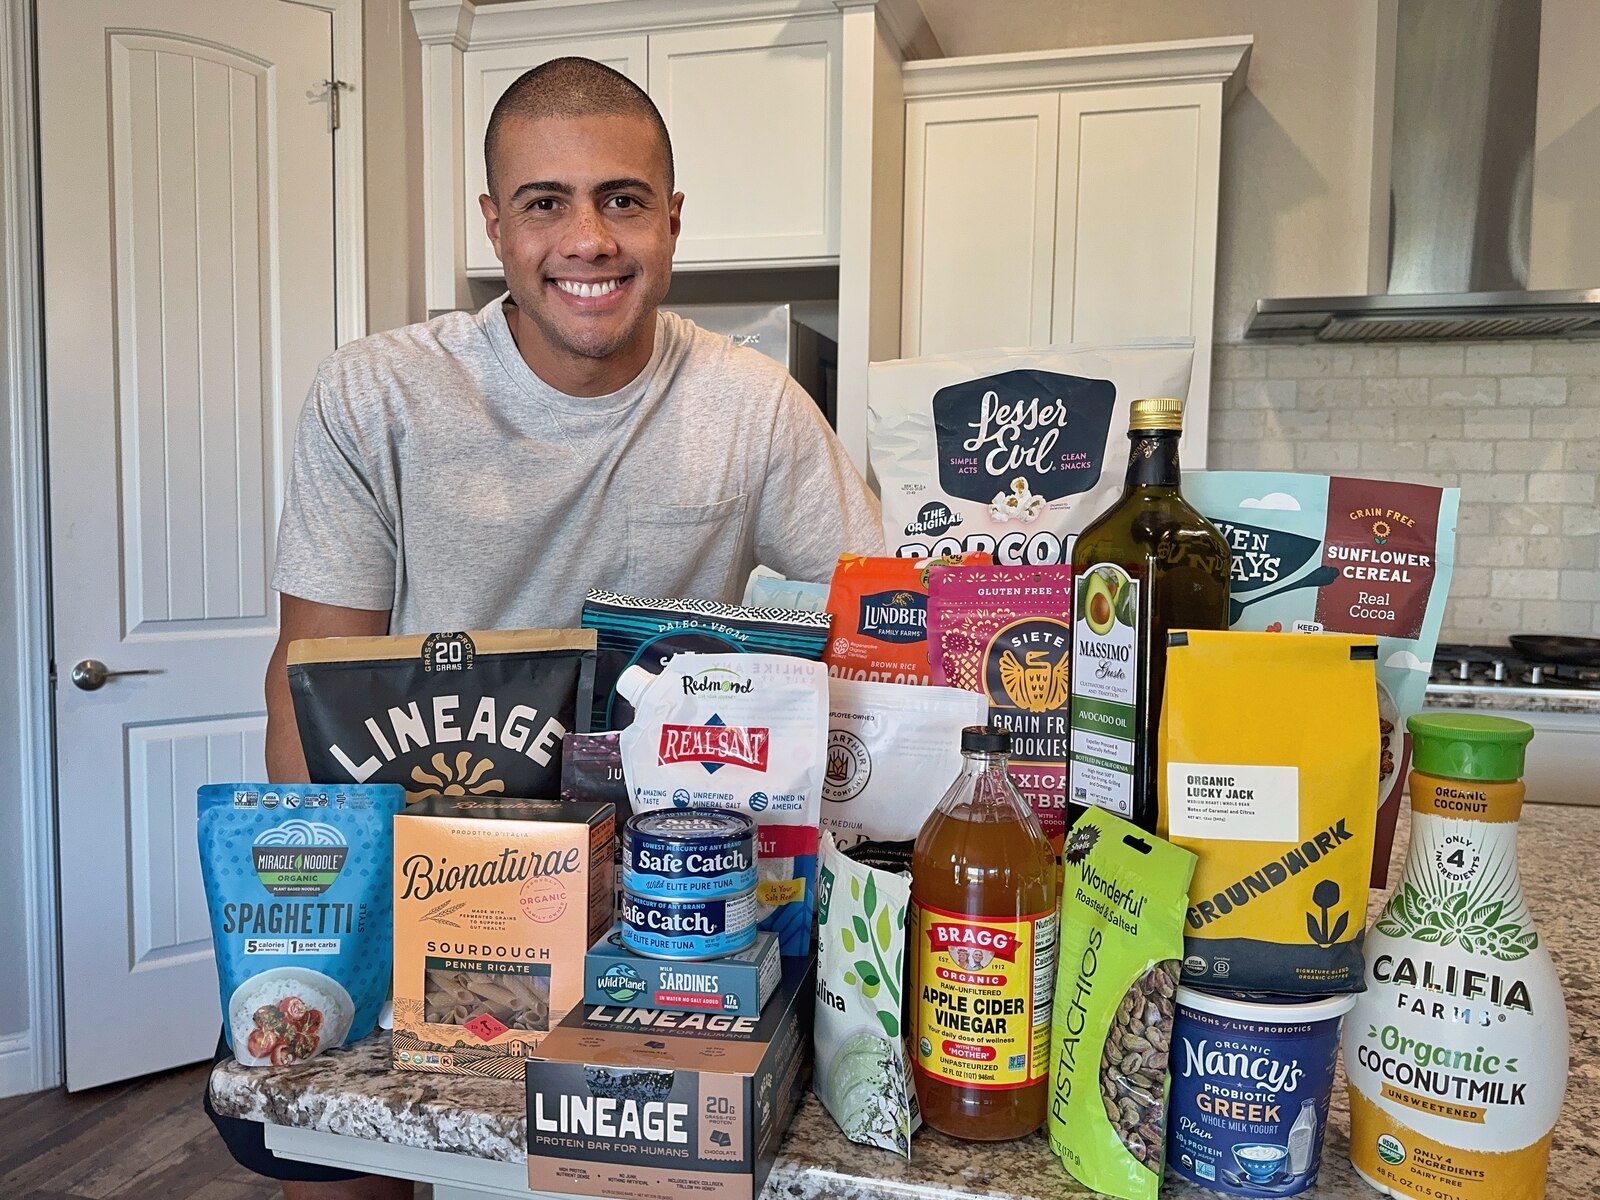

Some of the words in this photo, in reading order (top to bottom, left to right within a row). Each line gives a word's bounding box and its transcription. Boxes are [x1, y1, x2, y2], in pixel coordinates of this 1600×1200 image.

[964, 391, 1067, 452] Lesser
[986, 424, 1060, 476] Evil
[1061, 453, 1087, 461] CLEAN
[950, 457, 978, 466] SIMPLE
[958, 466, 978, 474] ACTS
[1060, 461, 1091, 470] SNACKS
[907, 513, 964, 533] ORIGINAL
[923, 508, 946, 521] THE
[1350, 508, 1382, 520] GRAIN
[1386, 509, 1415, 528] FREE
[1327, 546, 1431, 567] SUNFLOWER
[1343, 566, 1412, 583] CEREAL
[978, 587, 1021, 596] GLUTEN
[1024, 587, 1053, 595] FREE
[1358, 591, 1389, 605] Real
[1349, 605, 1395, 621] Cocoa
[658, 620, 698, 633] PALEO
[711, 622, 749, 642] VEGAN
[878, 628, 899, 636] FAMILY
[900, 629, 921, 637] FARMS
[1011, 632, 1064, 648] SIETE
[425, 632, 453, 672] GRASS-FED
[456, 633, 473, 670] PROTEIN
[435, 641, 462, 663] 20
[1079, 640, 1129, 662] MASSIMO
[870, 660, 898, 669] BROWN
[899, 663, 917, 671] RICE
[1095, 660, 1126, 680] Gusto
[993, 714, 1040, 734] GRAIN
[1079, 711, 1114, 725] AVOCADO
[1115, 718, 1127, 728] OIL
[329, 695, 566, 784] LINEAGE
[833, 734, 867, 766] ARTHUR
[833, 777, 863, 797] COMPANY
[1187, 775, 1235, 788] ORGANIC
[643, 789, 667, 797] AMAZING
[643, 798, 660, 806] TASTE
[693, 792, 734, 801] UNREFINED
[797, 794, 805, 802] IN
[1187, 787, 1222, 799] LUCKY
[1226, 788, 1254, 800] JACK
[1435, 786, 1487, 801] ORGANIC
[693, 801, 722, 809] MINERAL
[772, 803, 802, 811] AMERICA
[1434, 799, 1488, 813] COCONUT
[830, 818, 863, 829] MEDIUM
[642, 841, 665, 851] LOWEST
[709, 843, 722, 851] ANY
[723, 841, 742, 849] BRAND
[1071, 841, 1090, 851] Shells
[1078, 833, 1090, 841] No
[1445, 835, 1473, 848] ONLY
[258, 855, 293, 870] MIRACLE
[303, 855, 338, 870] NOODLE
[638, 850, 683, 872] Safe
[686, 849, 747, 873] Catch
[1435, 850, 1480, 881] INGREDIENTS
[1447, 849, 1465, 868] 4
[400, 848, 581, 900] Bionaturae
[1186, 818, 1354, 930] GROUNDWORK
[645, 880, 665, 890] Wild
[667, 882, 688, 891] ELITE
[690, 881, 711, 890] PURE
[714, 879, 733, 889] TUNA
[1081, 861, 1144, 918] Wonderful
[520, 892, 567, 905] ORGANIC
[633, 896, 657, 908] MERCURY
[658, 901, 666, 909] OF
[667, 902, 681, 910] ANY
[224, 903, 353, 934] SPAGHETTI
[358, 903, 367, 933] STYLE
[525, 906, 546, 921] FAMILY
[1075, 888, 1105, 915] Roasted
[1103, 907, 1109, 919] &
[1108, 912, 1137, 936] Salted
[647, 910, 716, 934] Catch
[247, 940, 257, 953] 5
[258, 941, 285, 949] calories
[290, 940, 297, 953] 1
[634, 932, 650, 945] ELITE
[650, 936, 671, 948] PURE
[672, 939, 695, 949] TUNA
[938, 926, 1008, 949] BRAGG
[427, 941, 550, 959] SOURDOUGH
[445, 960, 482, 971] PENNE
[488, 963, 530, 973] RIGATE
[938, 956, 950, 964] EST.
[597, 976, 618, 988] Wild
[618, 978, 646, 991] Planet
[659, 972, 719, 994] SARDINES
[942, 970, 1000, 985] ORGANIC
[1373, 954, 1533, 1015] CALIFIA
[940, 982, 1002, 996] RAW-UNFILTERED
[923, 986, 968, 1013] APPLE
[973, 998, 1025, 1015] CIDER
[587, 1005, 760, 1033] LINEAGE
[1397, 993, 1491, 1027] FARMS
[935, 1009, 1007, 1034] VINEGAR
[1053, 927, 1102, 1125] PISTACHIOS
[1181, 1008, 1219, 1026] BILLIONS
[1222, 1021, 1230, 1030] of
[1232, 1023, 1255, 1032] LIVE
[1258, 1025, 1312, 1033] PROBIOTICS
[582, 1021, 636, 1031] PROTEIN
[697, 1031, 751, 1039] HUMANS
[928, 1024, 940, 1035] Your
[941, 1029, 957, 1040] daily
[958, 1033, 975, 1043] dose
[976, 1035, 984, 1043] of
[985, 1036, 1015, 1044] wellness
[955, 1043, 969, 1051] WITH
[1215, 1041, 1271, 1056] ORGANIC
[1381, 1025, 1500, 1075] Organic
[940, 1056, 999, 1071] UNPASTEURIZED
[1182, 1037, 1303, 1093] Nancy's
[1358, 1045, 1527, 1106] COCONUTMILK
[1204, 1083, 1276, 1103] PROBIOTIC
[706, 1096, 735, 1115] 20G
[1196, 1093, 1282, 1123] GREEK
[1388, 1089, 1478, 1119] UNSWEETENED
[535, 1092, 688, 1144] LINEAGE
[1200, 1114, 1226, 1129] WHOLE
[1228, 1122, 1247, 1133] MILK
[1249, 1124, 1278, 1135] YOGURT
[1179, 1116, 1213, 1140] Plain
[536, 1135, 584, 1148] PROTEIN
[587, 1140, 610, 1151] BAR
[614, 1144, 637, 1154] FOR
[640, 1146, 689, 1158] HUMANS
[1382, 1138, 1399, 1151] USDA
[1414, 1148, 1442, 1161] ONLY
[1413, 1155, 1485, 1177] INGREDIENTS
[1376, 1166, 1386, 1176] 48
[1387, 1173, 1397, 1182] FL
[1399, 1177, 1412, 1189] OZ
[1415, 1185, 1432, 1196] (1.5
[1410, 1166, 1437, 1181] DAIRY
[1440, 1177, 1462, 1188] FREE
